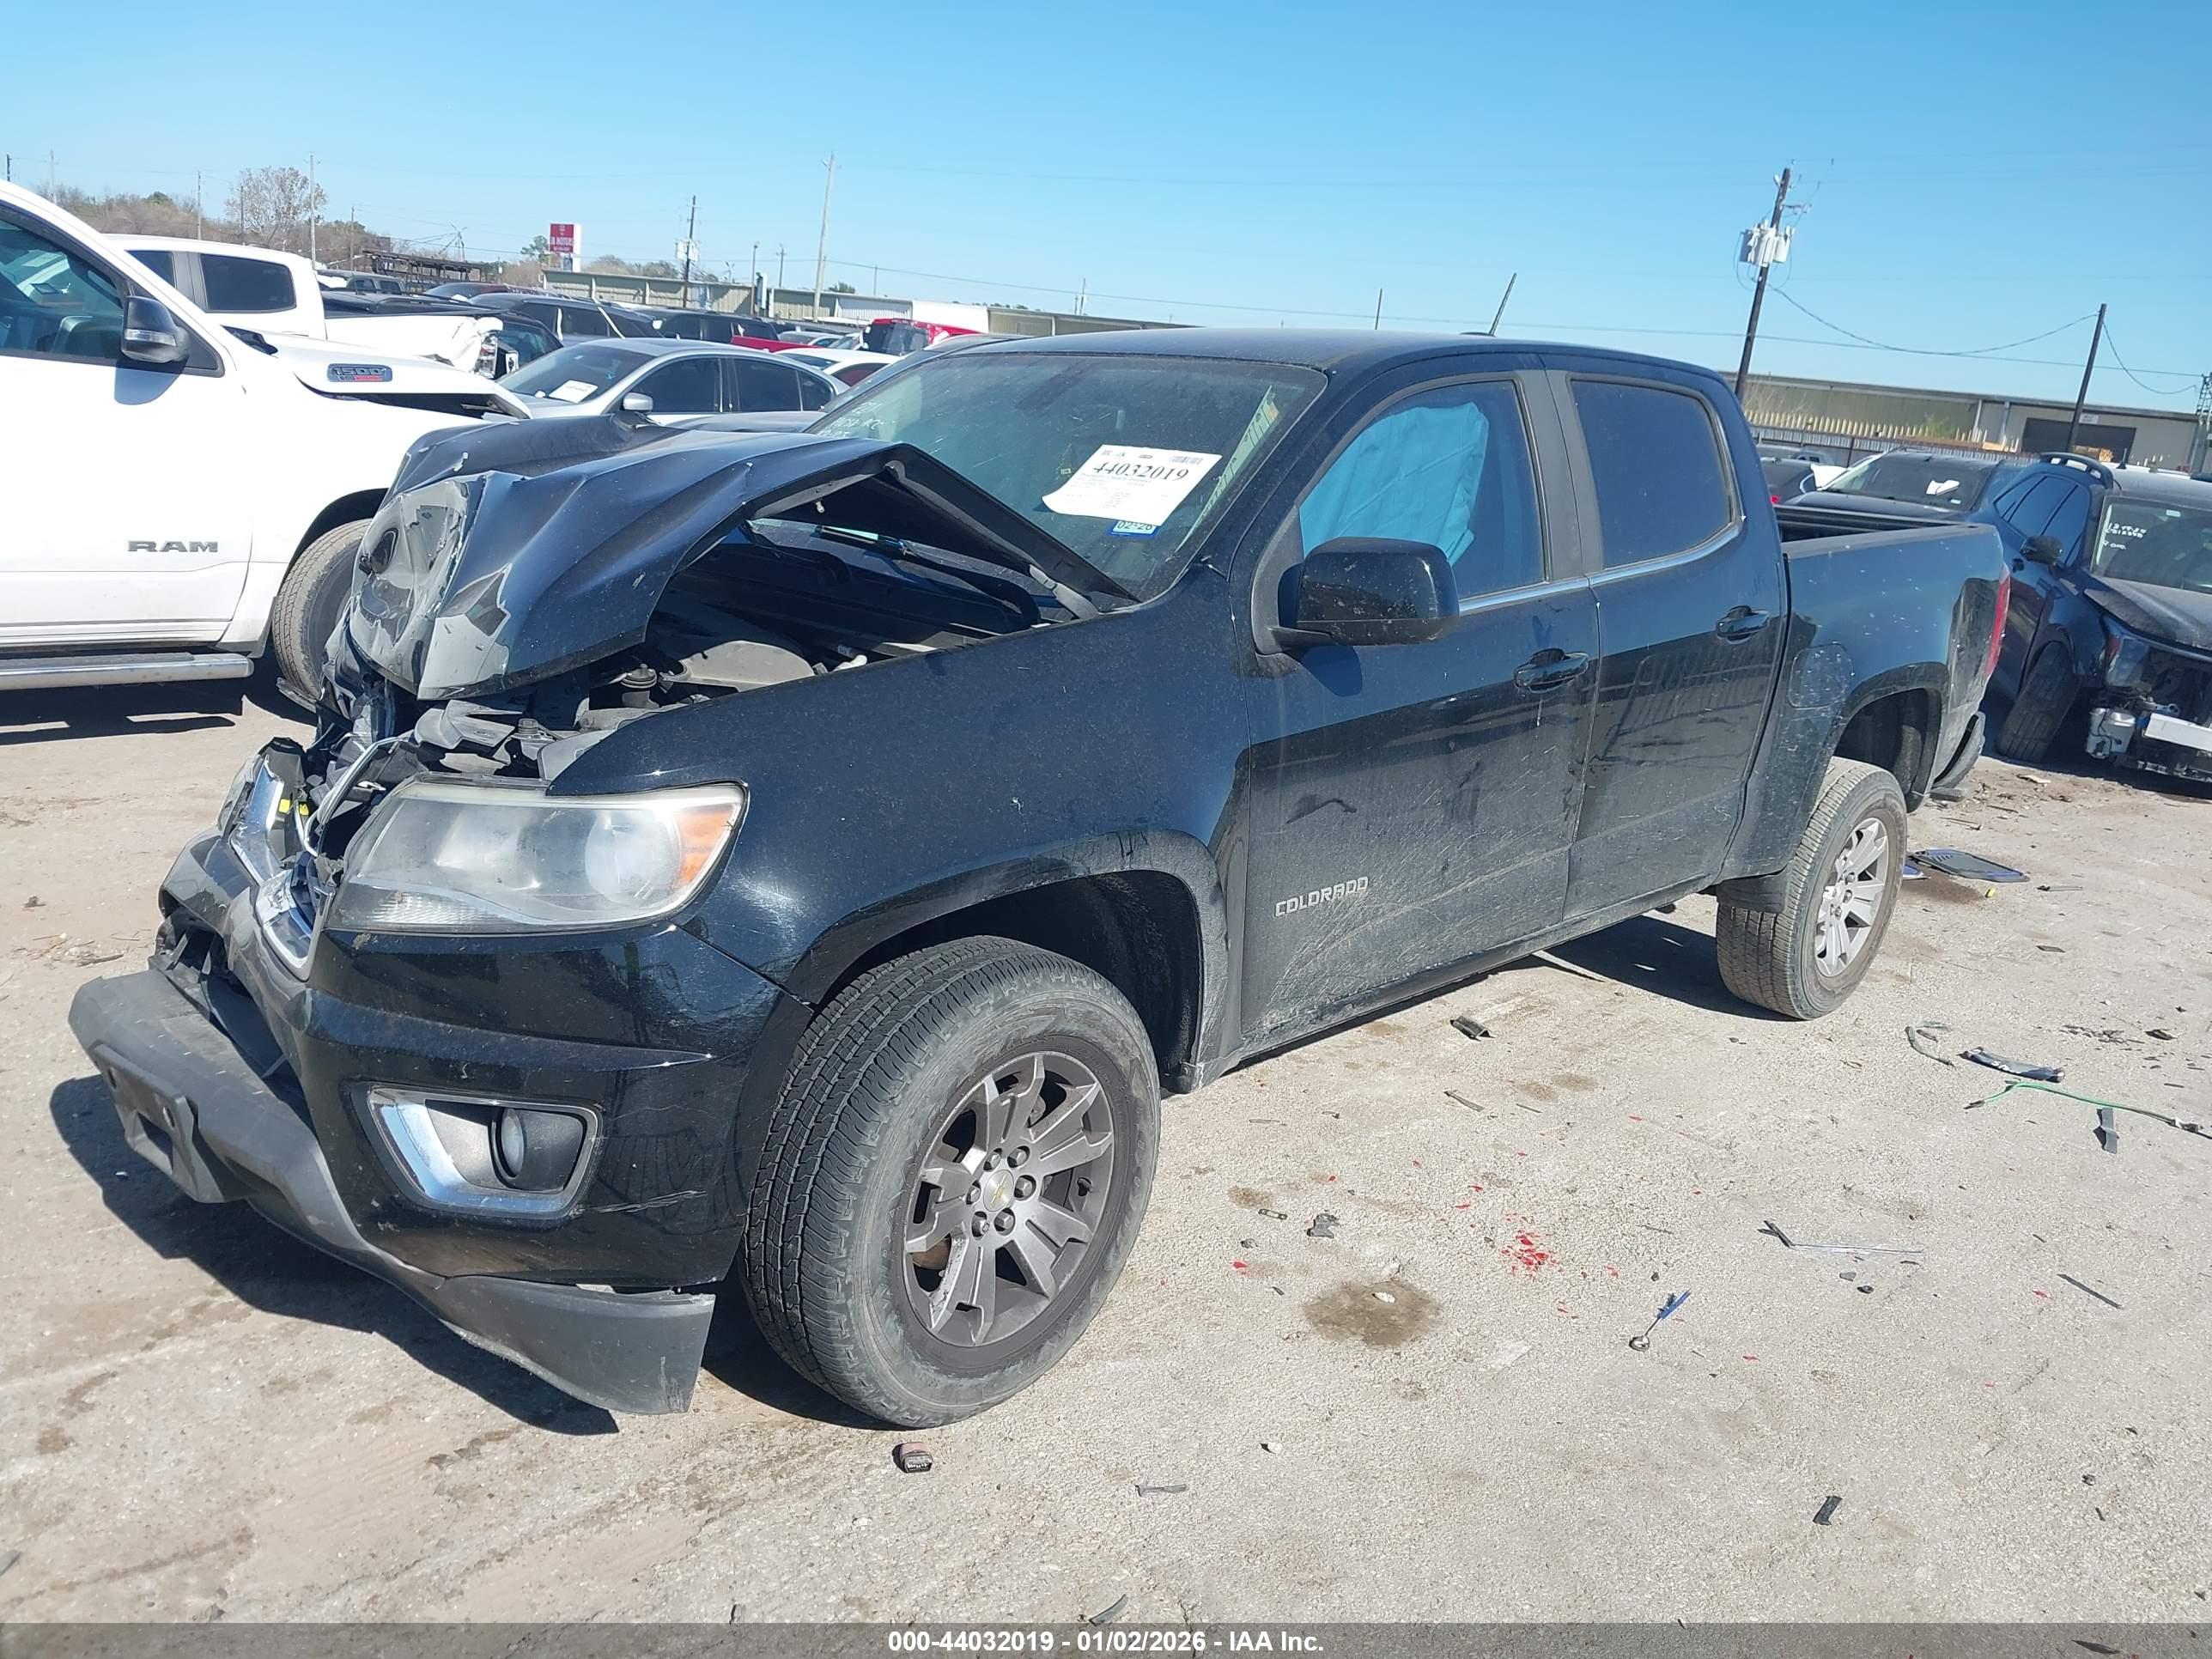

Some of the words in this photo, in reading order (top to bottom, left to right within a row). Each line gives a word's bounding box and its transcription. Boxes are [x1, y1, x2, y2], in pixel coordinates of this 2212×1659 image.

[332, 367, 386, 375] 1500
[1093, 462, 1189, 481] 44032019
[128, 540, 218, 552] RAM
[1274, 876, 1369, 917] COLORADO
